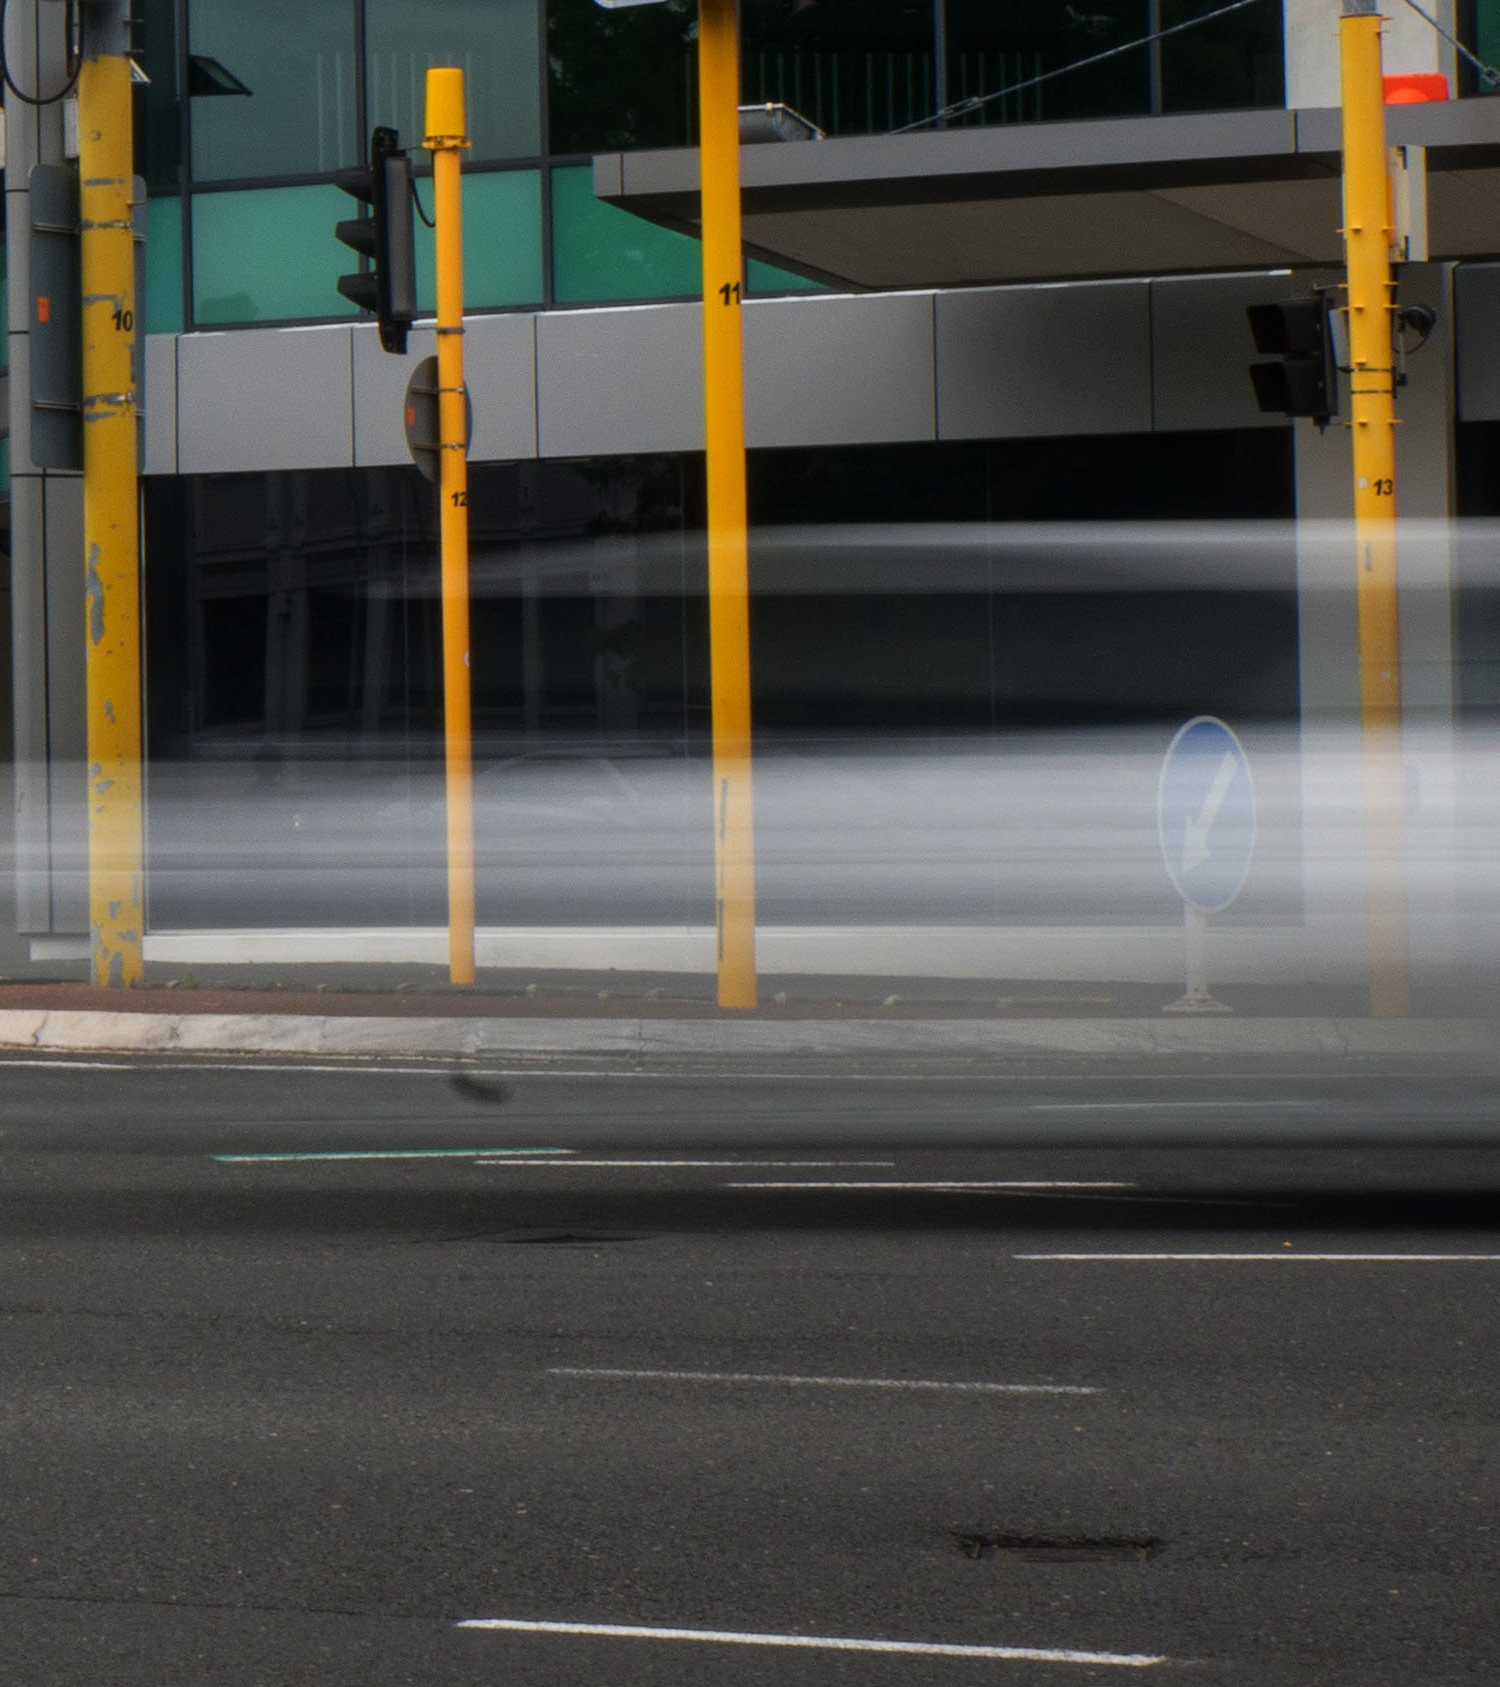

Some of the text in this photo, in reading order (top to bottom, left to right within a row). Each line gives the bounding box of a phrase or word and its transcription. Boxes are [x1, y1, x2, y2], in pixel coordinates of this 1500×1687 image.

[719, 282, 740, 306] 11
[112, 310, 133, 332] 10
[1373, 479, 1393, 496] 13
[451, 492, 467, 507] 12
